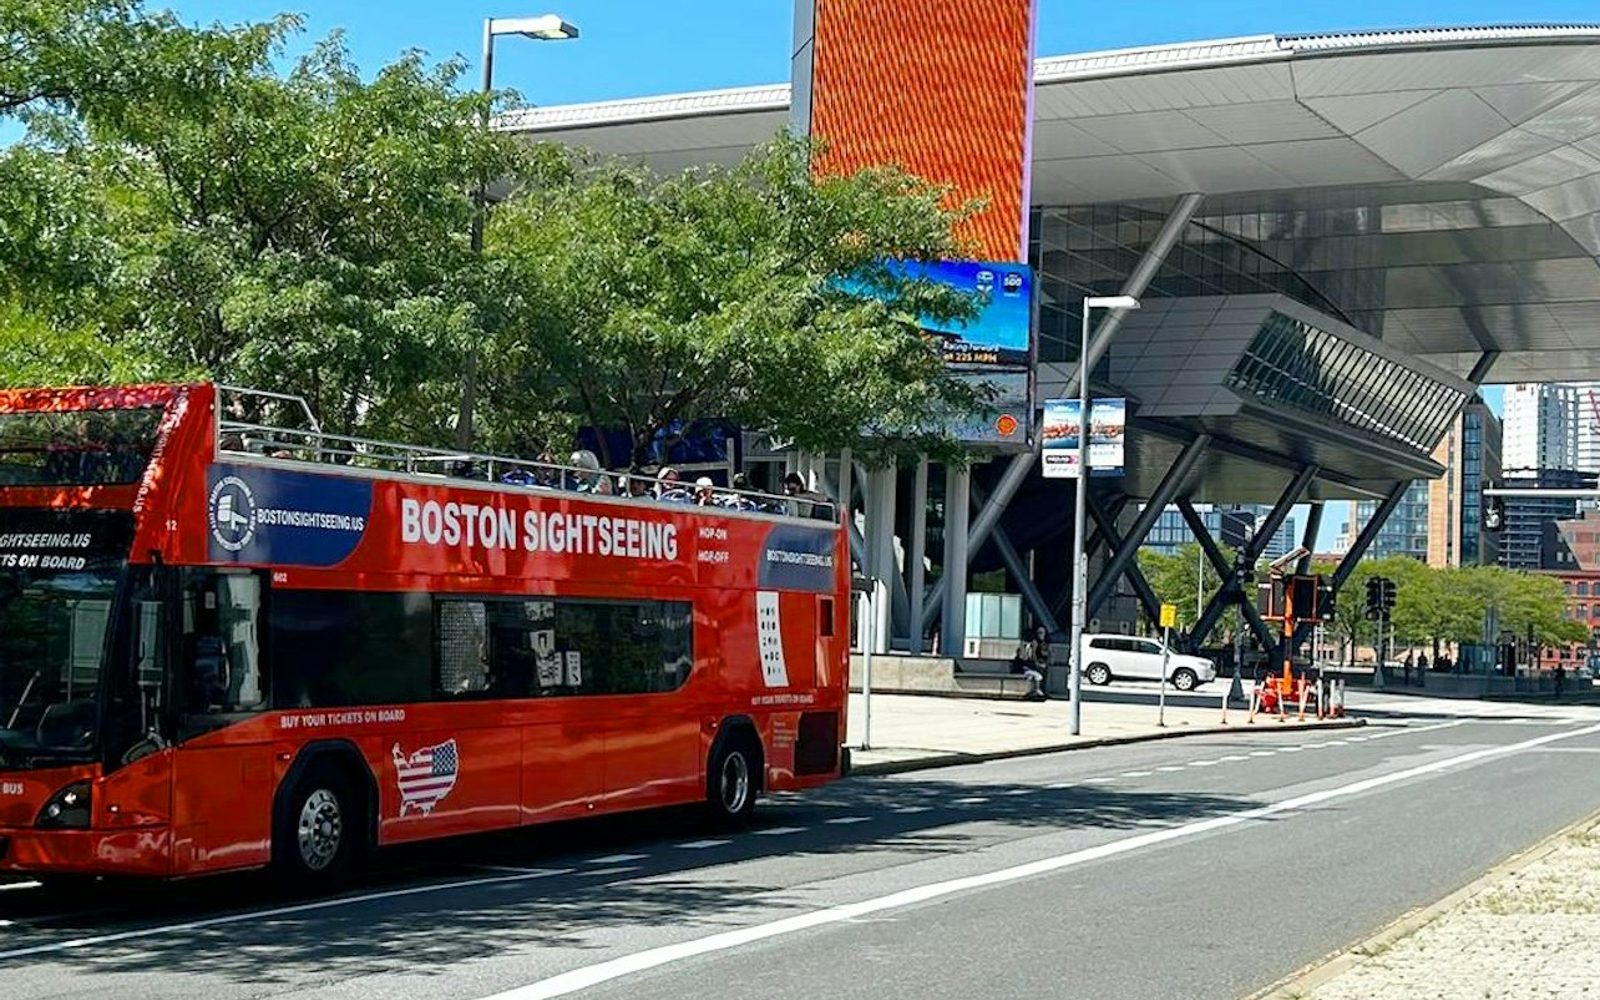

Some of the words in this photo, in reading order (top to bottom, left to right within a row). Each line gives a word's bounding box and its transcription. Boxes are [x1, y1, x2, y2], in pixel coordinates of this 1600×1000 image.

[165, 519, 177, 531] 12
[257, 508, 365, 531] BOSTONSIGHTSEEING.US
[402, 498, 517, 550] BOSTON
[523, 510, 678, 561] SIGHTSEEING
[18, 554, 40, 568] ON
[40, 555, 86, 571] BOARD
[280, 715, 300, 729] BUY
[301, 713, 327, 727] YOUR
[327, 711, 363, 725] TICKETS
[363, 710, 378, 723] ON
[378, 709, 406, 722] BOARD
[3, 782, 25, 795] BUS
